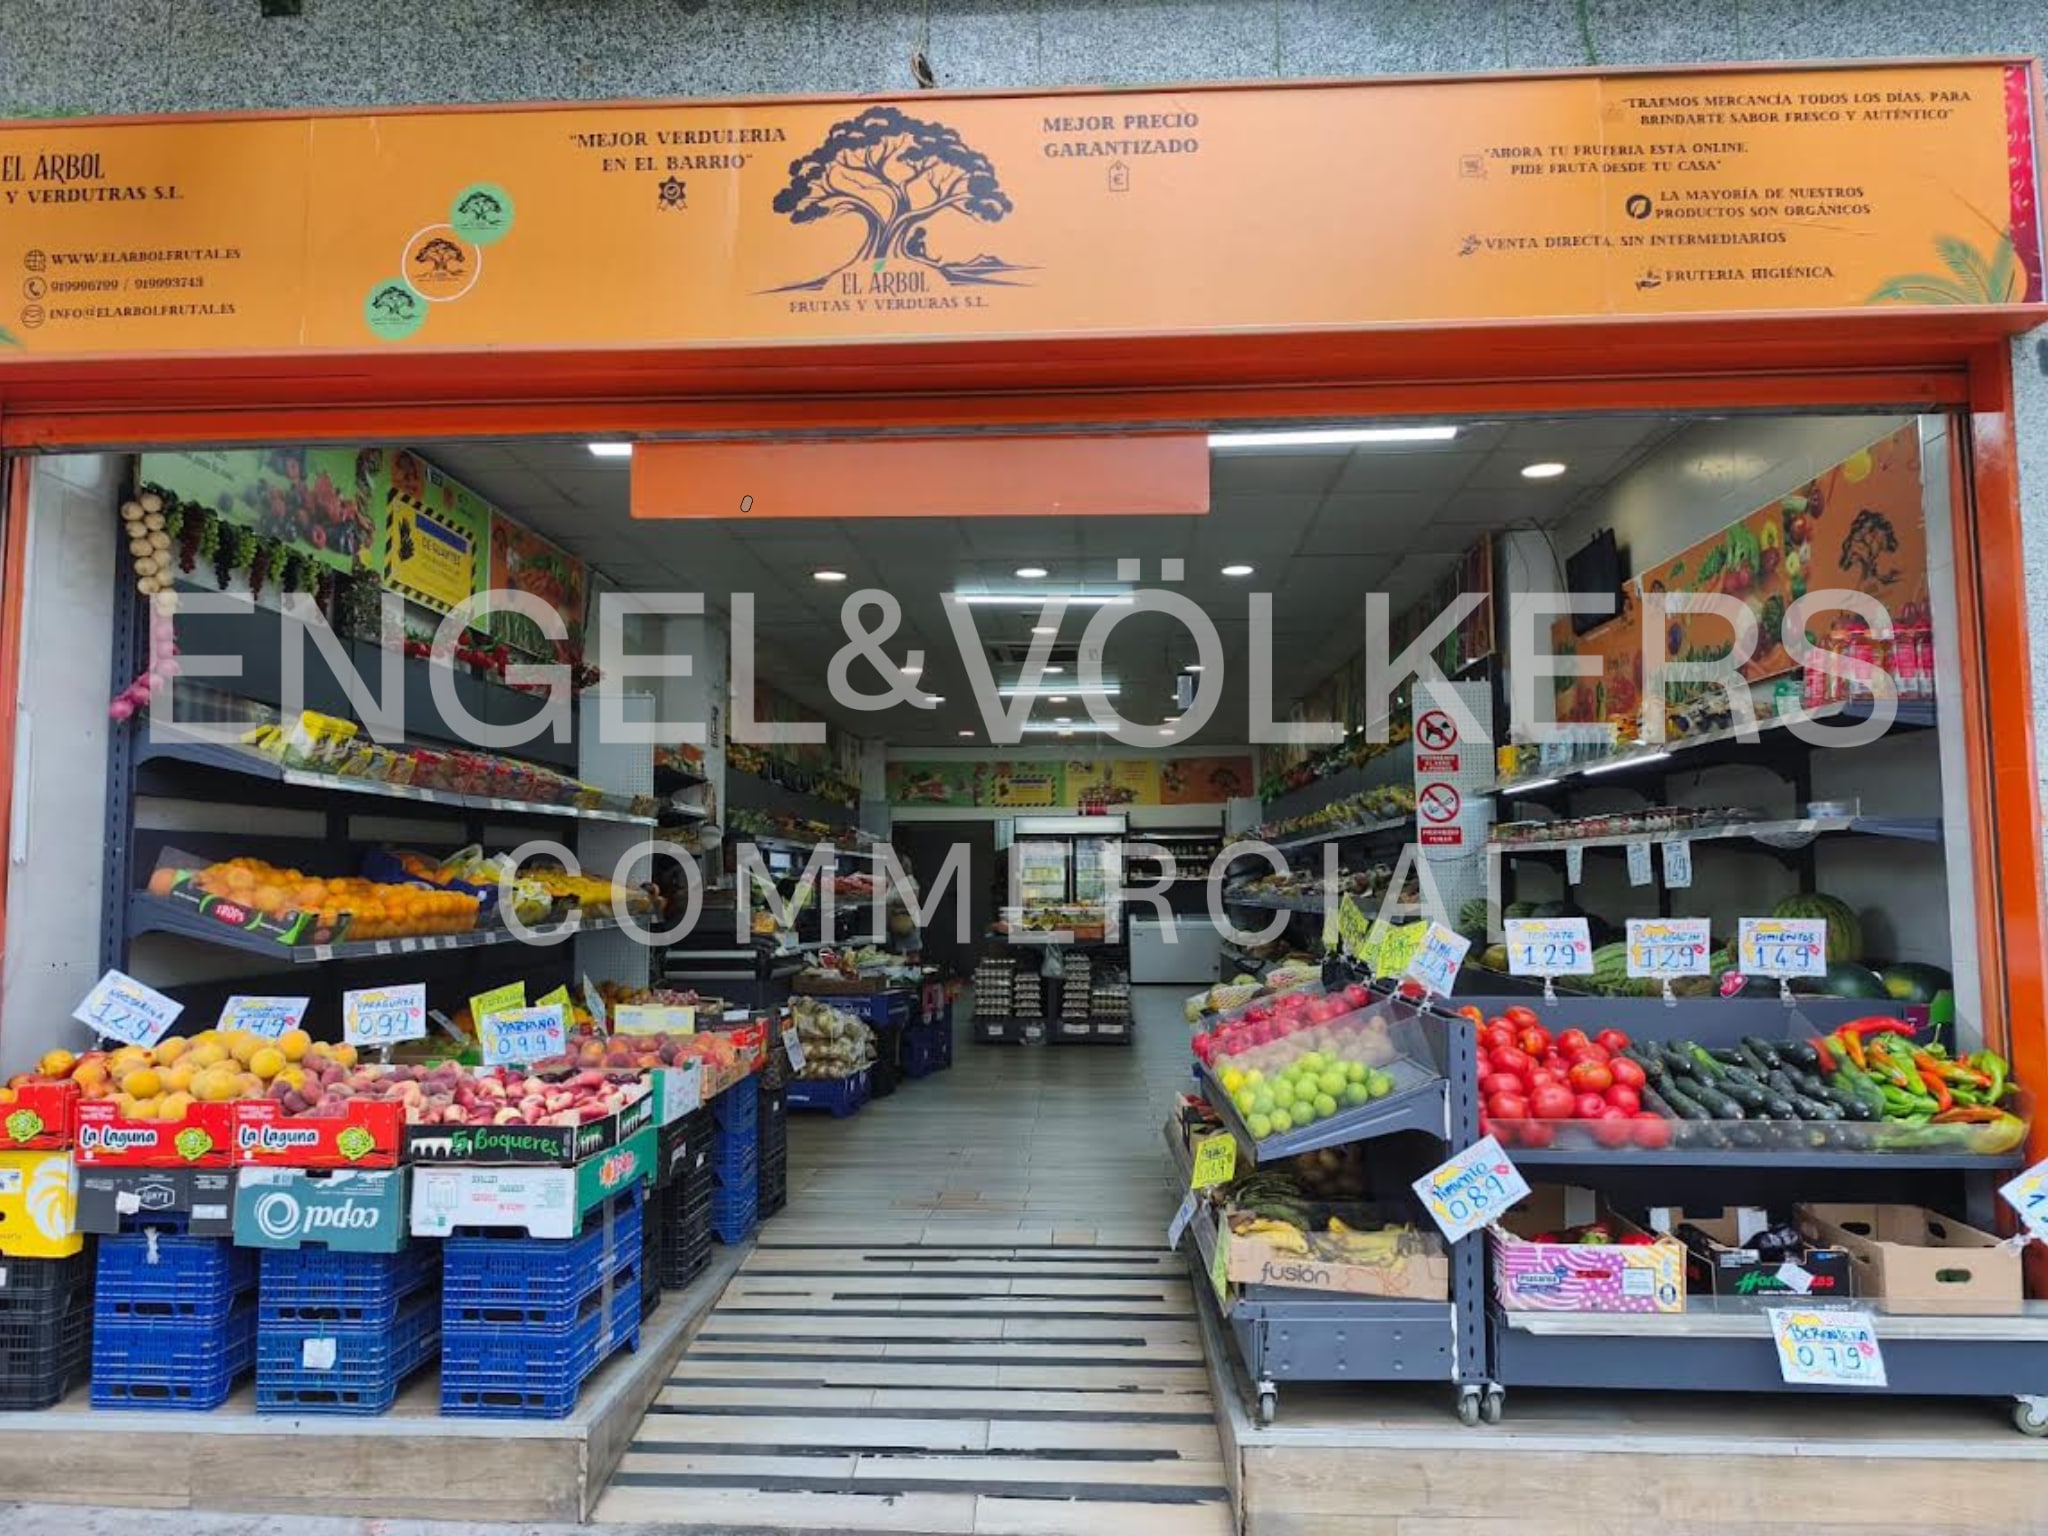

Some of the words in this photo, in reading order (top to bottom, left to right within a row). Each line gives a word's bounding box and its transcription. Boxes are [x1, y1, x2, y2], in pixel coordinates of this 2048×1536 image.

[1799, 94, 1848, 105] TODOS
[1854, 92, 1881, 104] LOS
[1930, 90, 1971, 102] PARA
[1043, 115, 1115, 133] MEJOR
[1124, 112, 1198, 130] PRECIO
[1640, 113, 1723, 125] BRINDARTE
[1730, 111, 1779, 123] SABOR
[1785, 110, 1840, 122] FRESCO
[1846, 110, 1856, 121] Y
[657, 127, 786, 145] VERDULERIA
[1043, 138, 1199, 158] GARANTIZADO
[1550, 146, 1568, 157] TU
[2, 155, 25, 182] EL
[602, 157, 628, 172] EN
[636, 156, 658, 171] EL
[1511, 164, 1544, 175] PIDE
[1549, 162, 1599, 174] FRUTA
[1603, 162, 1647, 173] DESDE
[1653, 161, 1672, 172] TU
[7, 190, 18, 205] Y
[28, 186, 147, 203] VERDUTRAS
[1660, 191, 1680, 201] LA
[1685, 187, 1759, 200] MAYORÍA
[1764, 189, 1784, 199] DE
[1789, 187, 1864, 199] NUESTROS
[1655, 206, 1745, 219] PRODUCTOS
[1750, 206, 1778, 217] SON
[1784, 203, 1871, 216] ORGÁNICOS
[1486, 237, 1538, 249] VENTA
[1620, 236, 1644, 246] SIN
[1650, 232, 1787, 246] INTERMEDIARIOS
[1751, 265, 1834, 280] HIGIÉNICA
[842, 274, 862, 296] EL
[790, 302, 850, 314] FRUTAS
[857, 300, 868, 312] Y
[874, 298, 958, 311] VERDURAS
[1755, 932, 1815, 944] PIMIENTOS
[104, 1127, 156, 1146] Laguna
[264, 1126, 317, 1146] Laguna
[303, 1198, 379, 1234] copal
